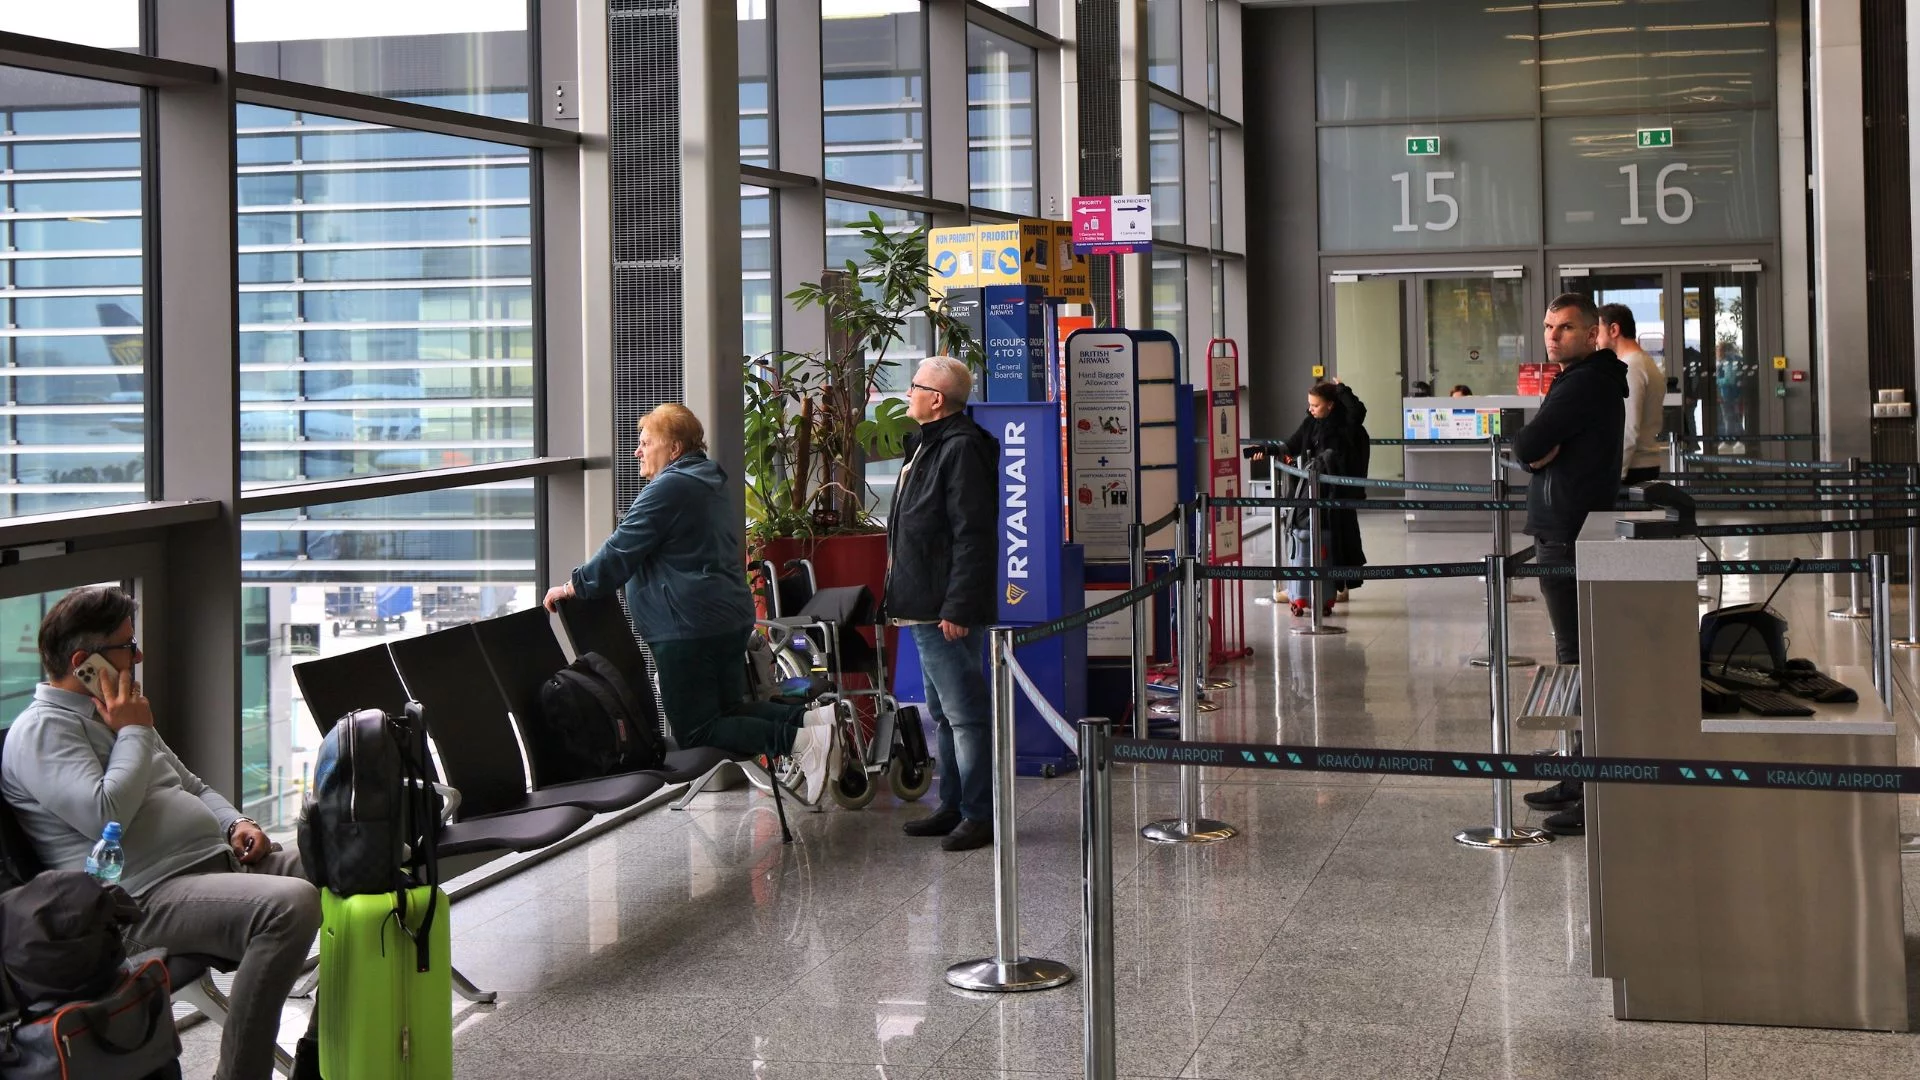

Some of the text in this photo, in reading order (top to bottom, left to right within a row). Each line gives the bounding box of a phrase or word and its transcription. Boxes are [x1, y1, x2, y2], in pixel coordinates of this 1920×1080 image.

[1619, 163, 1694, 225] 16
[1391, 171, 1459, 232] 15
[981, 230, 1019, 242] PRIORITY
[1024, 225, 1048, 235] PRIORITY
[936, 232, 975, 244] NON PRIORITY
[1029, 275, 1041, 283] SMALL
[1064, 275, 1077, 283] SMALL
[1064, 288, 1076, 296] CABIN
[990, 338, 1026, 346] GROUPS
[994, 349, 1022, 357] 4 TO 9
[1005, 422, 1028, 578] RYANAIR
[1362, 568, 1395, 577] AIRPORT
[1807, 563, 1840, 572] AIRPORT
[296, 632, 312, 646] 18
[1114, 744, 1224, 762] KRAKÓW AIRPORT
[1317, 754, 1434, 772] KRAKÓW AIRPORT
[1534, 762, 1659, 780] KRAKÓW AIRPORT
[1766, 770, 1902, 789] KRAKÓW AIRPORT
